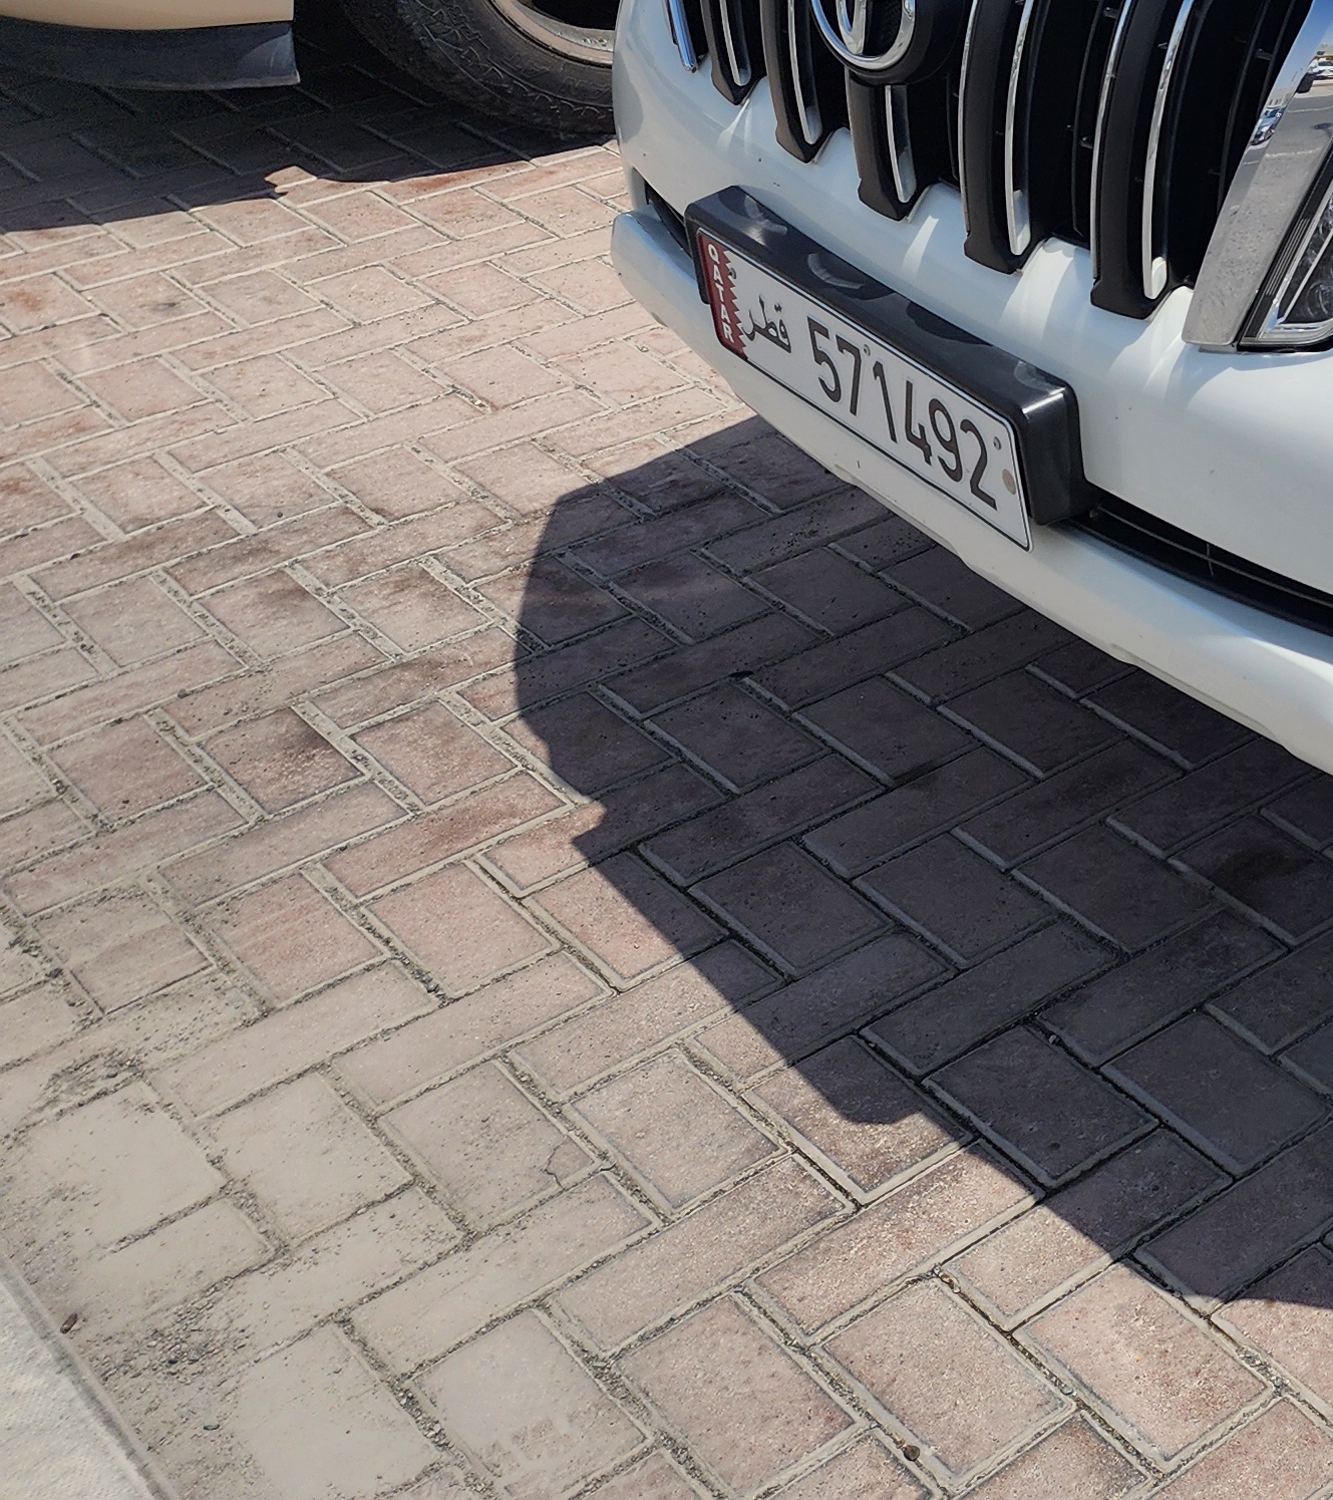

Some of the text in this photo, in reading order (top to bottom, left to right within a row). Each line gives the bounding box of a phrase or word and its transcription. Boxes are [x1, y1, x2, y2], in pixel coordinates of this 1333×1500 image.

[707, 243, 733, 343] QATAR
[744, 295, 792, 354] قطر
[807, 317, 998, 511] 571492
